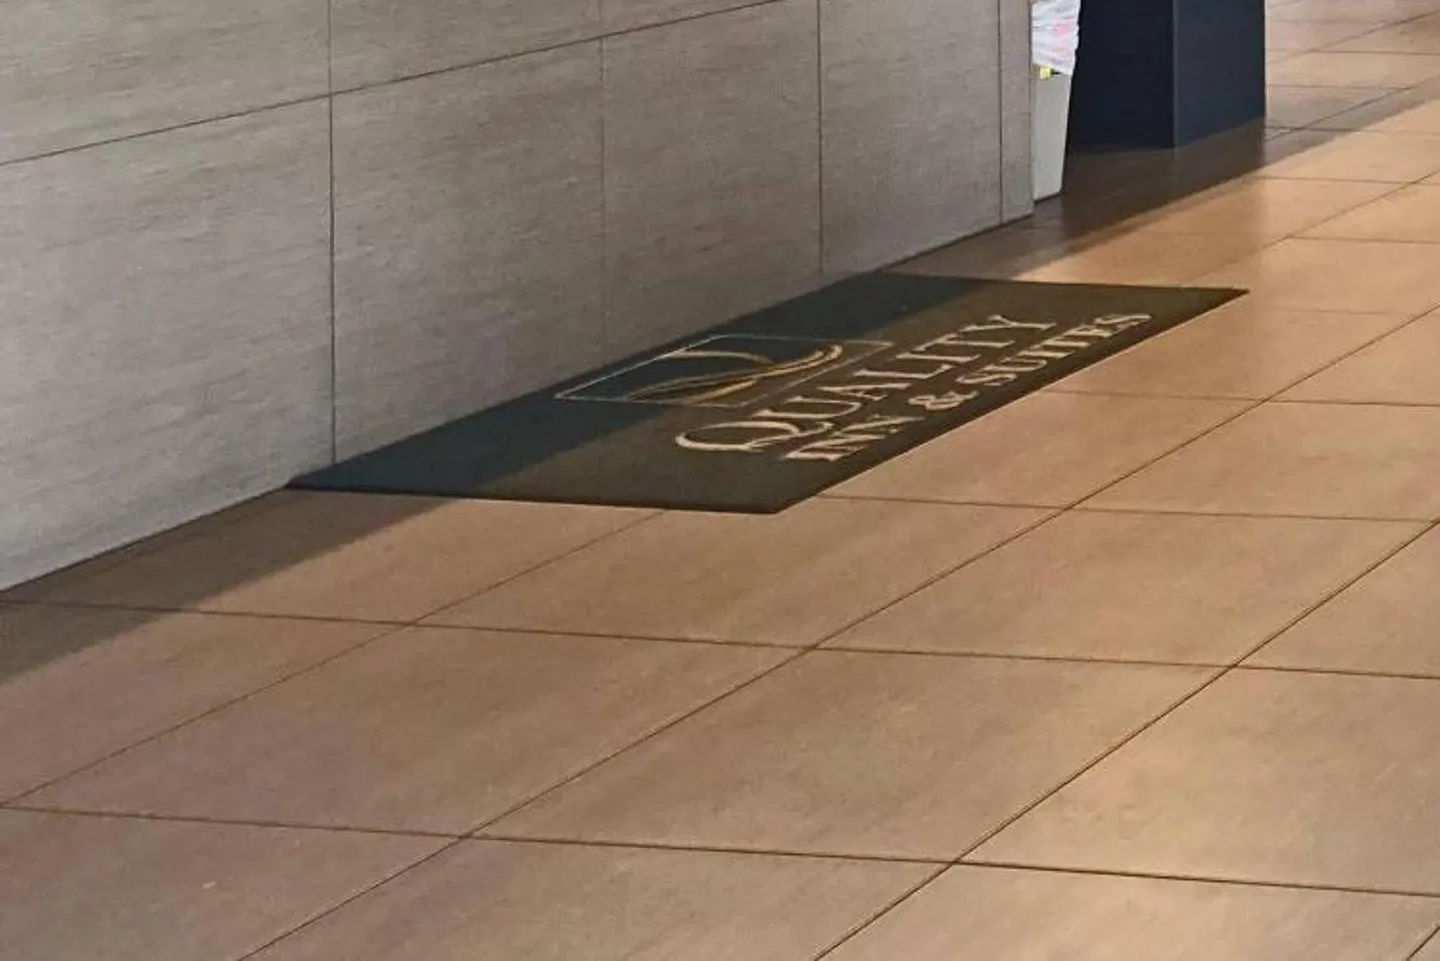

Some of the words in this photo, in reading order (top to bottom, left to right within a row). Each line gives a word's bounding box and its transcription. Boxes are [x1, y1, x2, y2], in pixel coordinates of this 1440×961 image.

[675, 314, 1057, 453] QUALITY
[782, 413, 926, 462] INN
[907, 389, 979, 411] &
[956, 312, 1152, 387] SUITES
